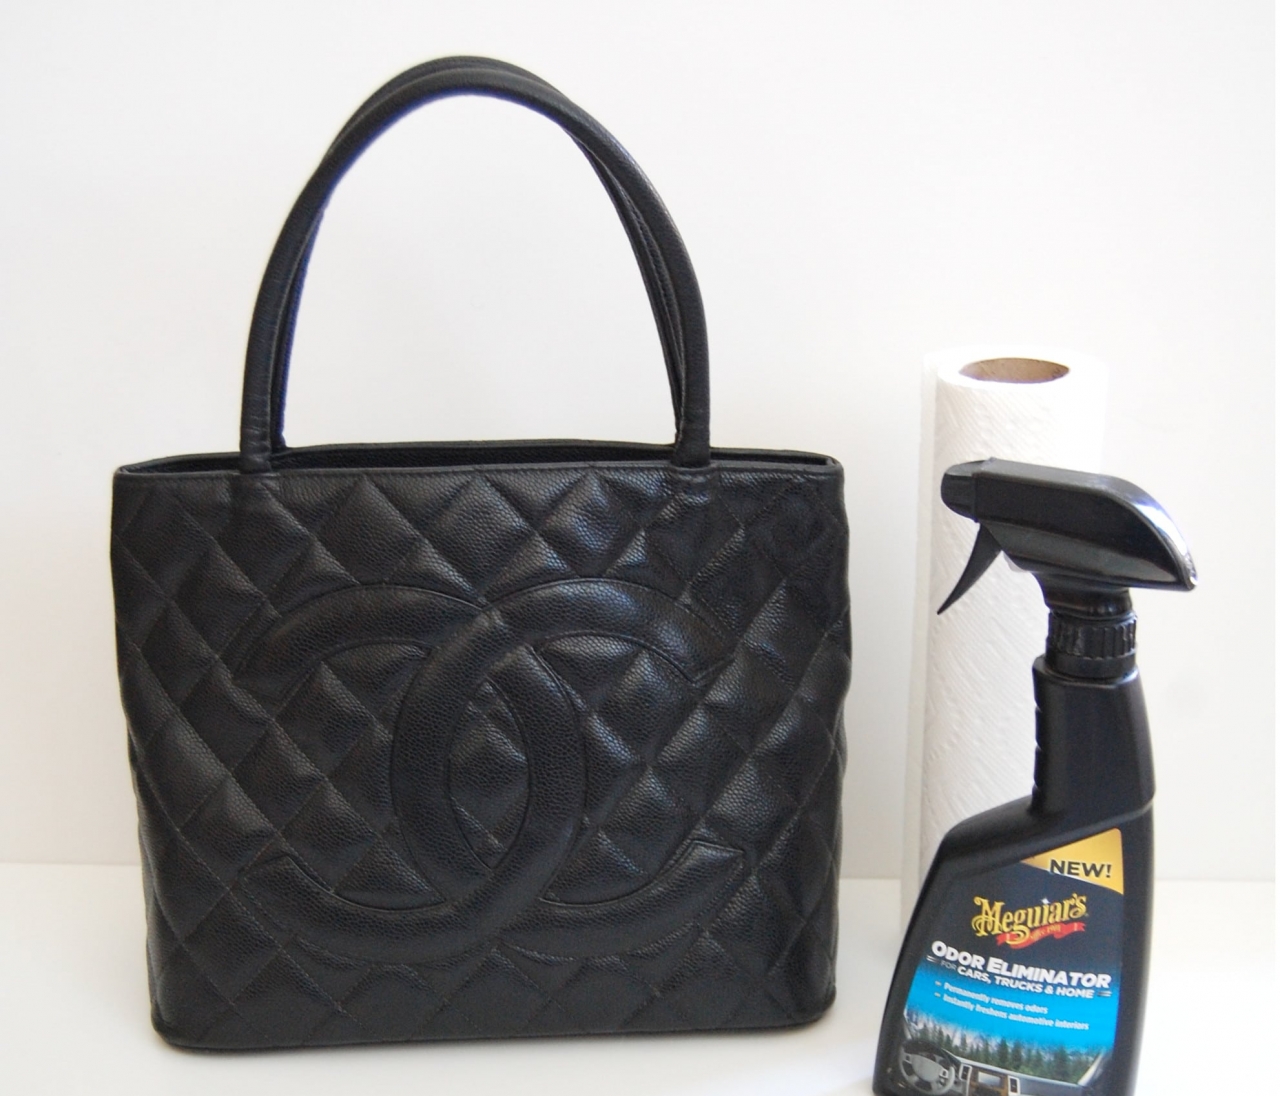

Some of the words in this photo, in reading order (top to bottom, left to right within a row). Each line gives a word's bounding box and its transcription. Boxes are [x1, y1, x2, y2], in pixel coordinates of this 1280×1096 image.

[1050, 859, 1112, 878] NEW!
[972, 893, 1087, 944] Meguiar's
[932, 940, 985, 970] ODOR
[987, 957, 1111, 988] ELIMINATOR
[957, 966, 992, 984] CARS,
[994, 975, 1044, 993] TRUCKS
[1044, 985, 1054, 994] &
[1056, 986, 1095, 998] HOME
[991, 997, 1024, 1011] removes
[1025, 1003, 1048, 1014] odors
